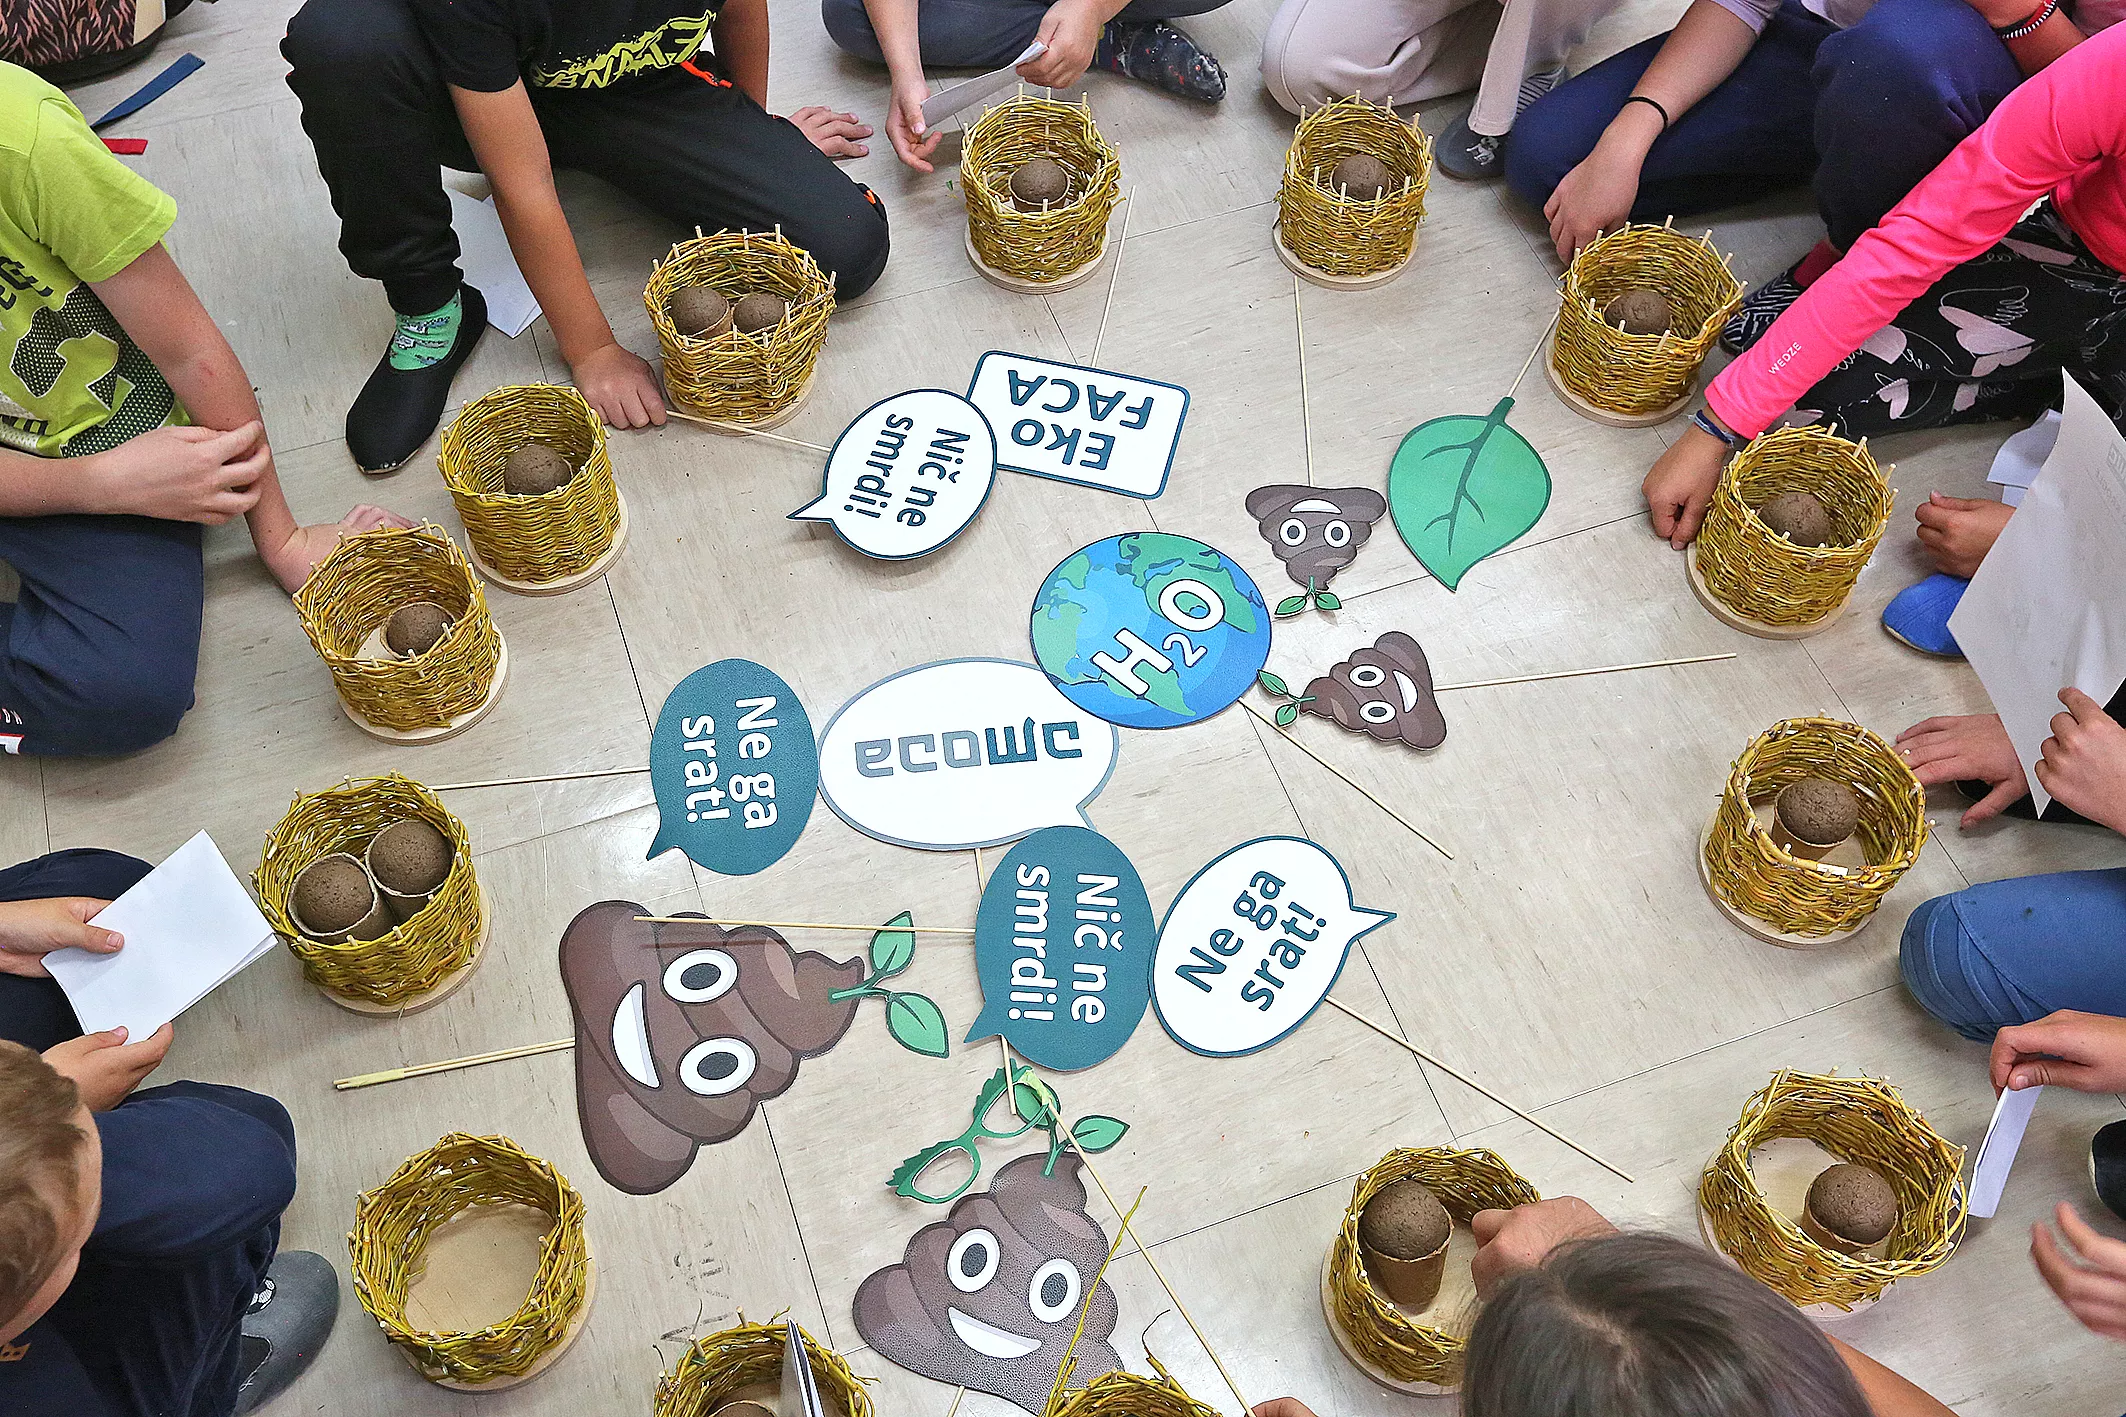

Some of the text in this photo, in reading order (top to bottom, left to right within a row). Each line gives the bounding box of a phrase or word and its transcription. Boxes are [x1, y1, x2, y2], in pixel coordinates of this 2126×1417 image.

[1007, 369, 1155, 431] FACA
[1767, 341, 1802, 375] WEDZE
[843, 413, 914, 519] smrdi!
[896, 427, 966, 527] Nič ne
[1091, 579, 1225, 697] H2O
[681, 715, 731, 823] srat!
[728, 696, 779, 830] Ne ga
[854, 716, 1083, 779] ecowc
[1008, 863, 1058, 1021] smrdi!
[1070, 874, 1124, 1024] Nič ne
[1174, 870, 1287, 994] Ne ga
[1240, 901, 1327, 1012] srat!
